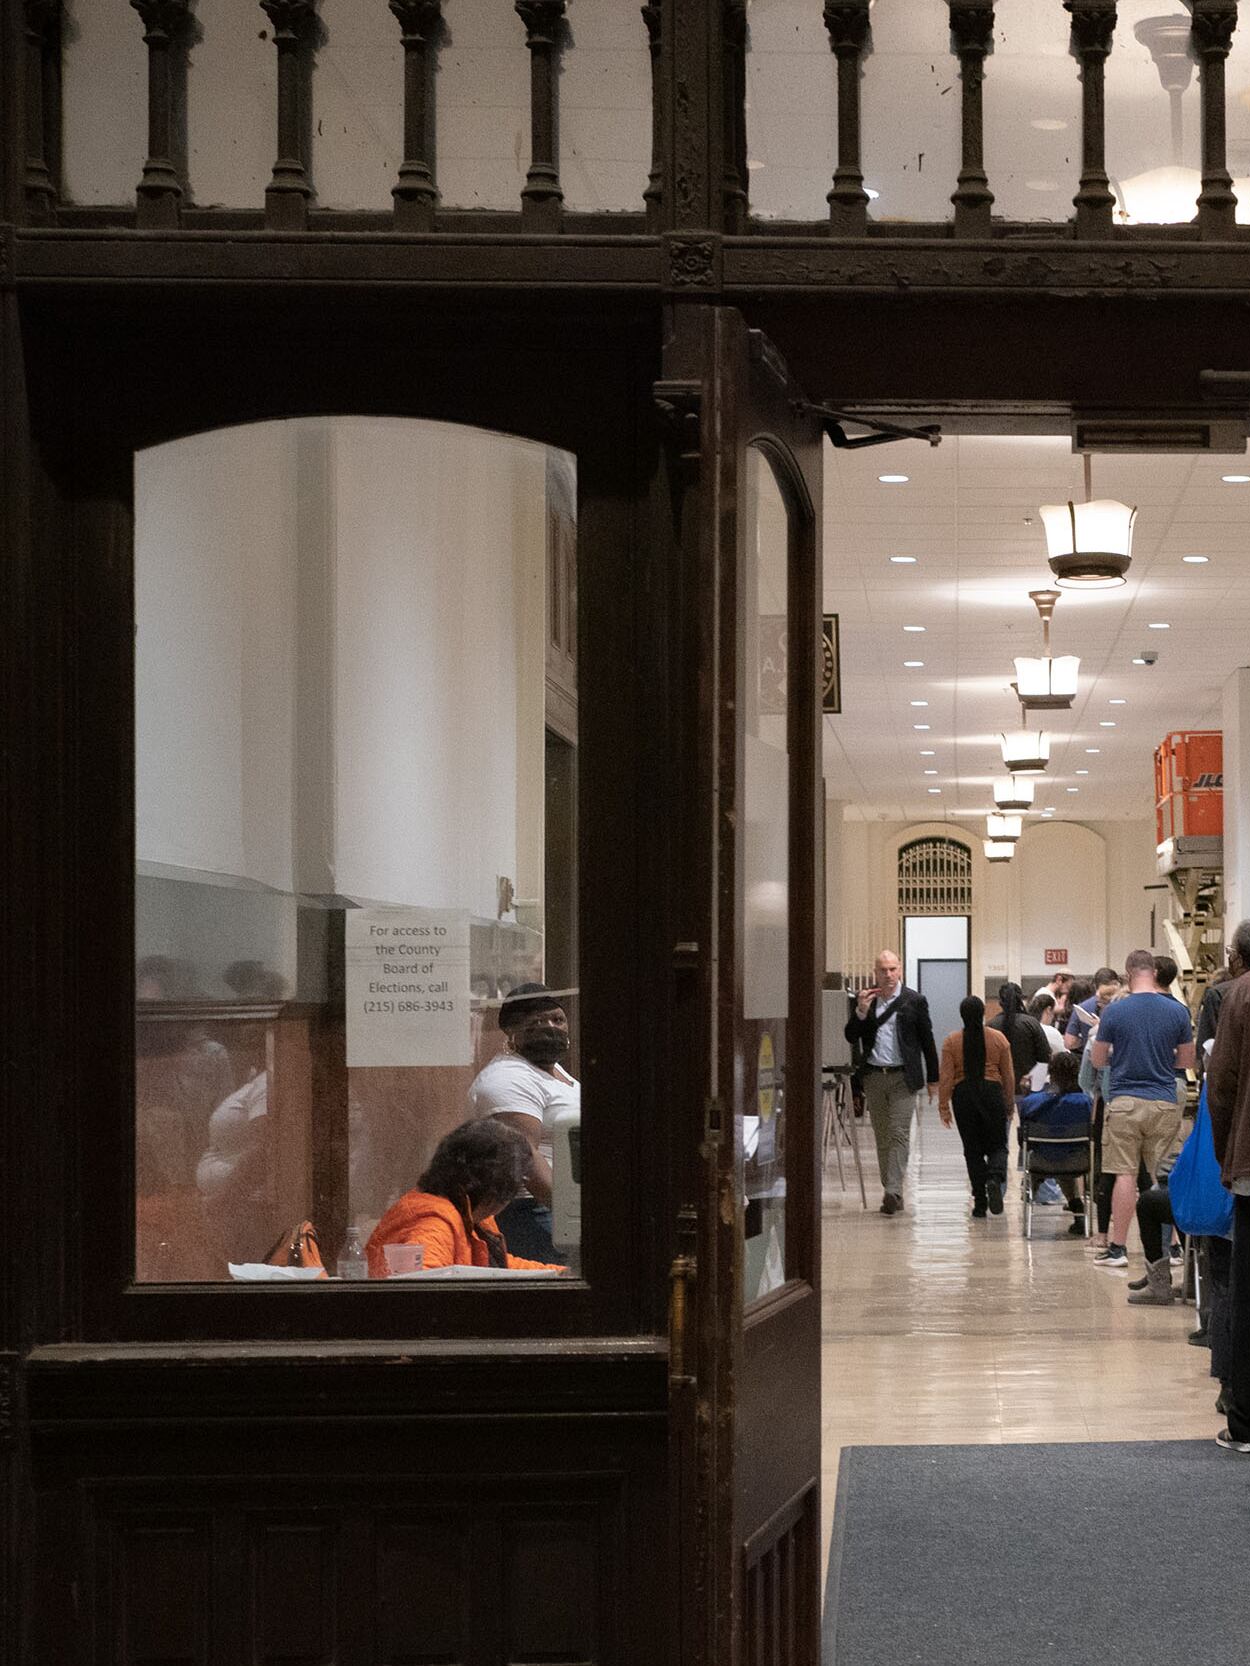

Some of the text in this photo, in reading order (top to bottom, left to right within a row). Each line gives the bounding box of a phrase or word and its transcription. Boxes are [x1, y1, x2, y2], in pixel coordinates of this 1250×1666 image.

[369, 926, 447, 936] For access to
[375, 944, 441, 957] the County
[1046, 951, 1066, 963] EXIT
[383, 962, 434, 974] Board of
[369, 982, 448, 994] Elections, call
[364, 1001, 454, 1014] (215) 686-3943
